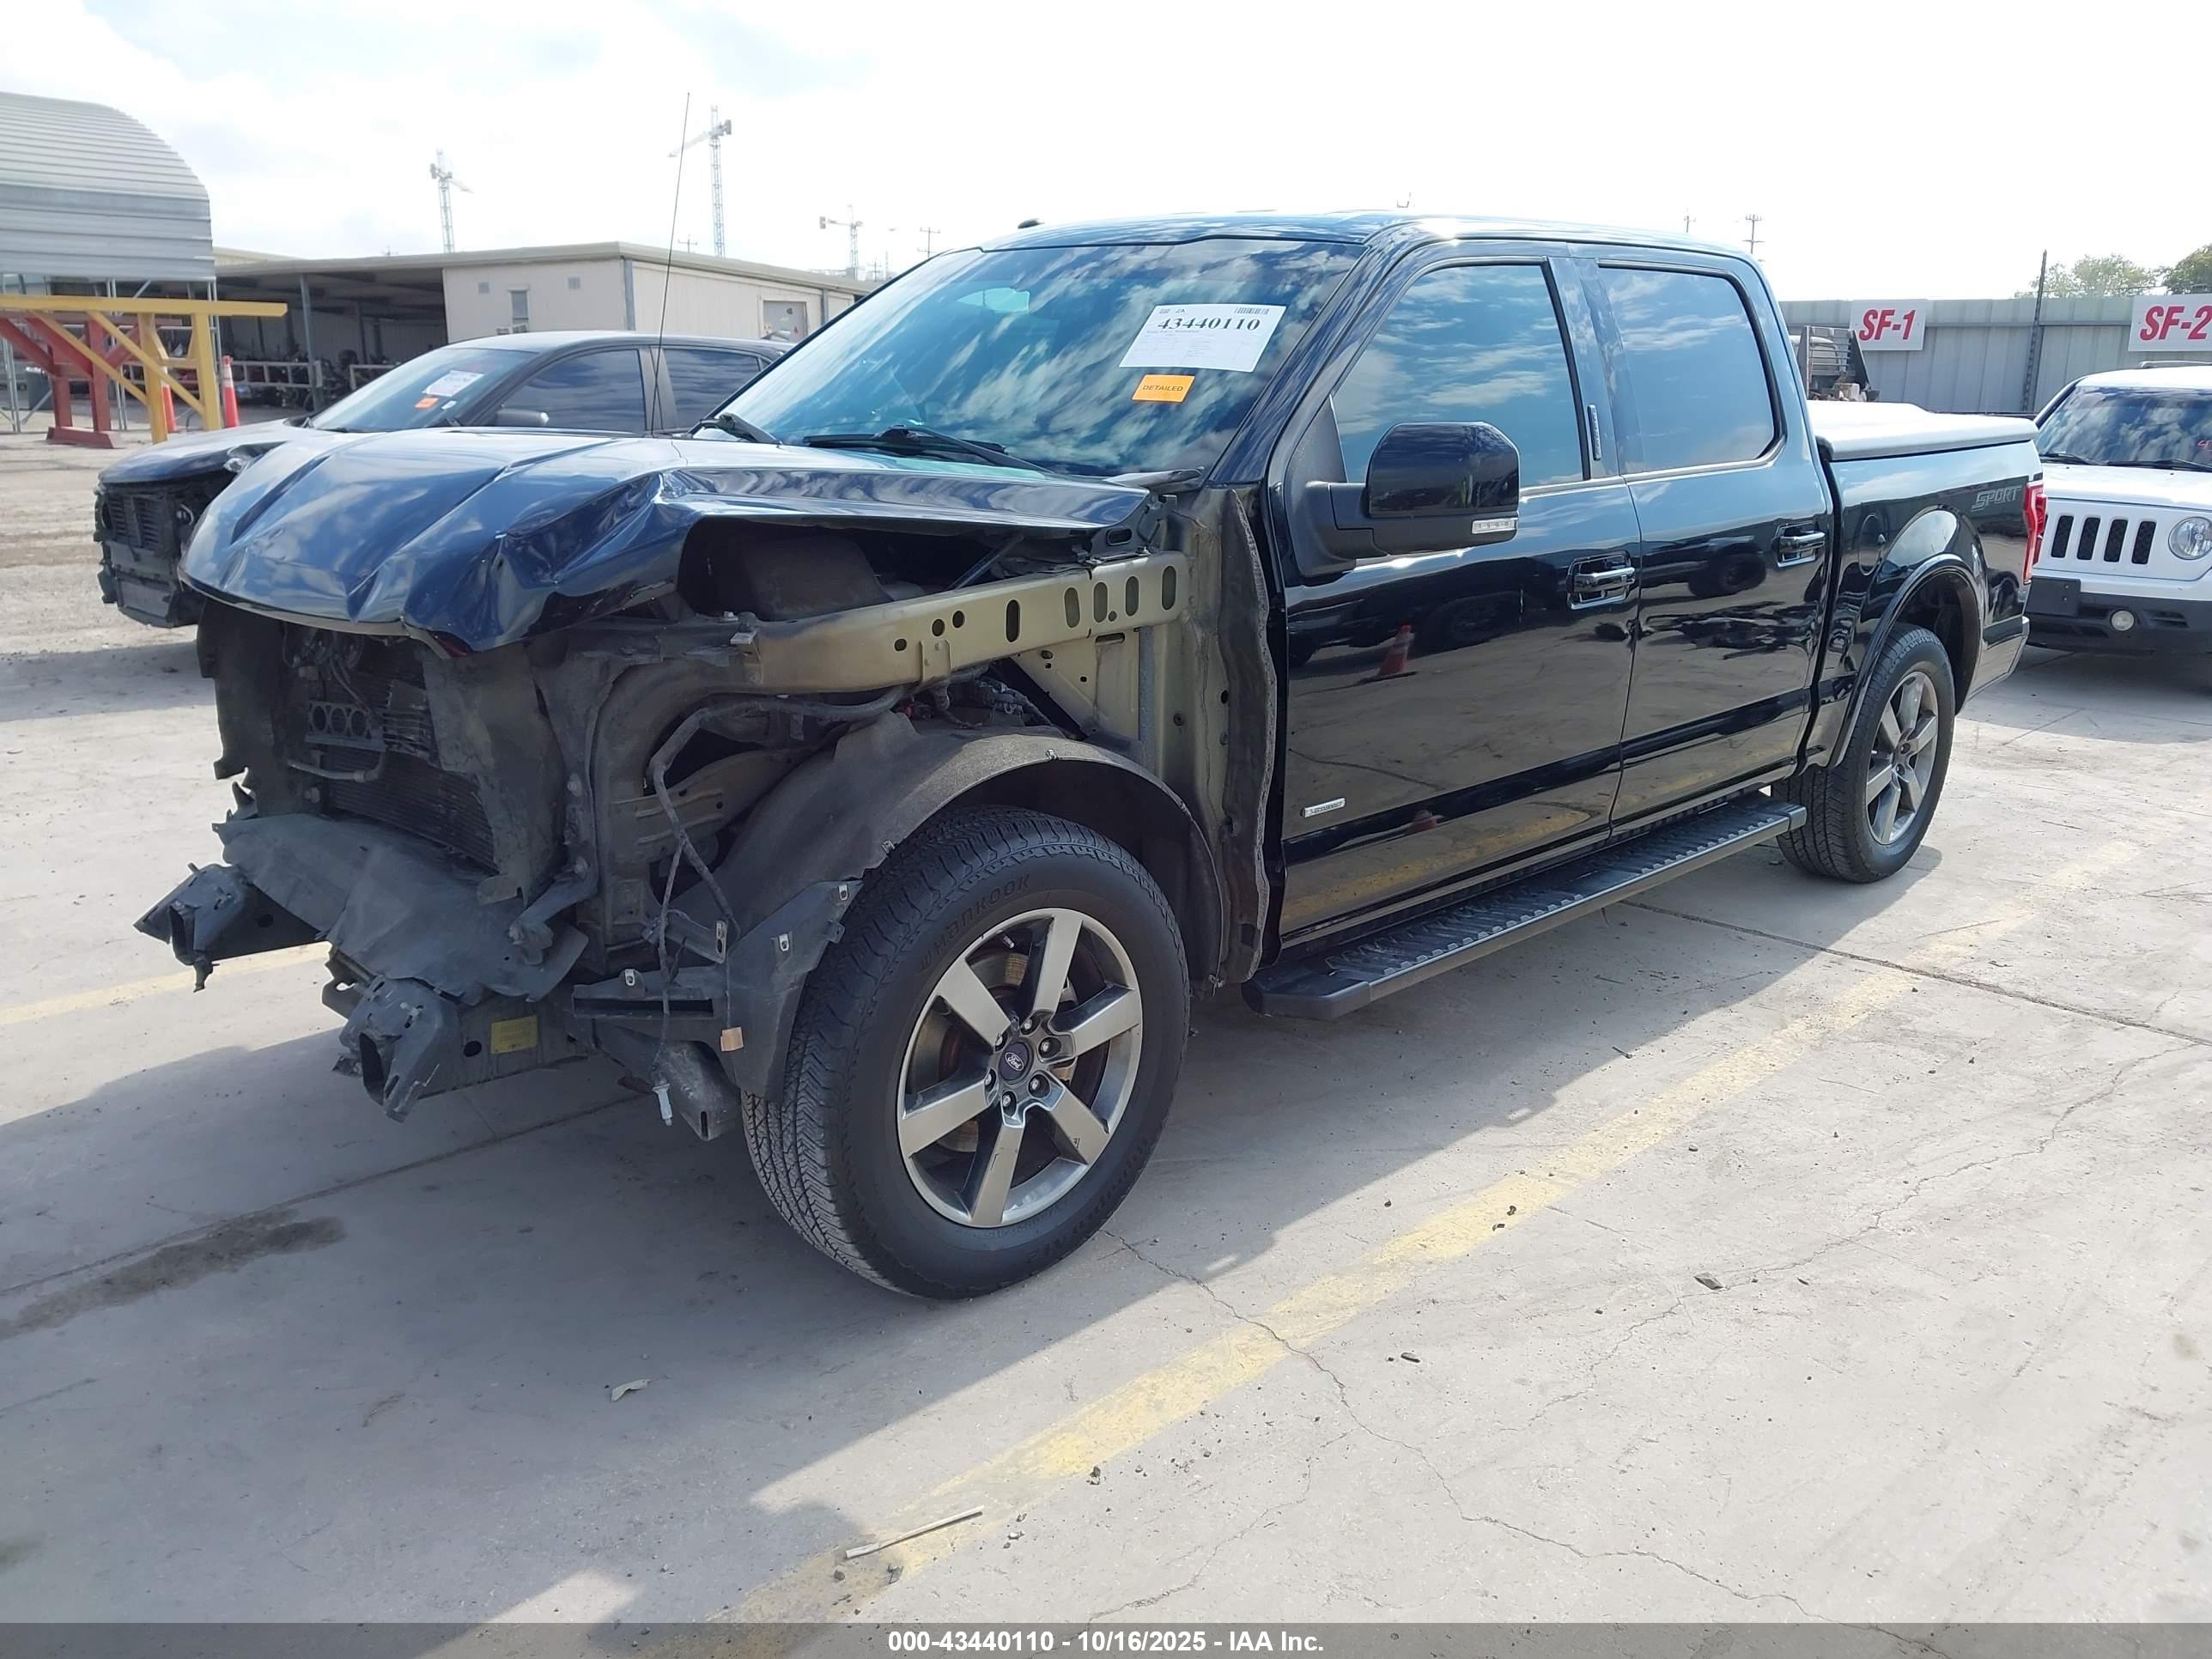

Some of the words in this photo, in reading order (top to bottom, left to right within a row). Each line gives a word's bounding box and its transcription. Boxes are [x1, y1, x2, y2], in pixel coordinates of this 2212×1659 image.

[1158, 317, 1261, 331] 43440110
[1858, 309, 1917, 341] SF-1
[2139, 305, 2212, 341] SF-2
[1971, 484, 2023, 512] SPORT
